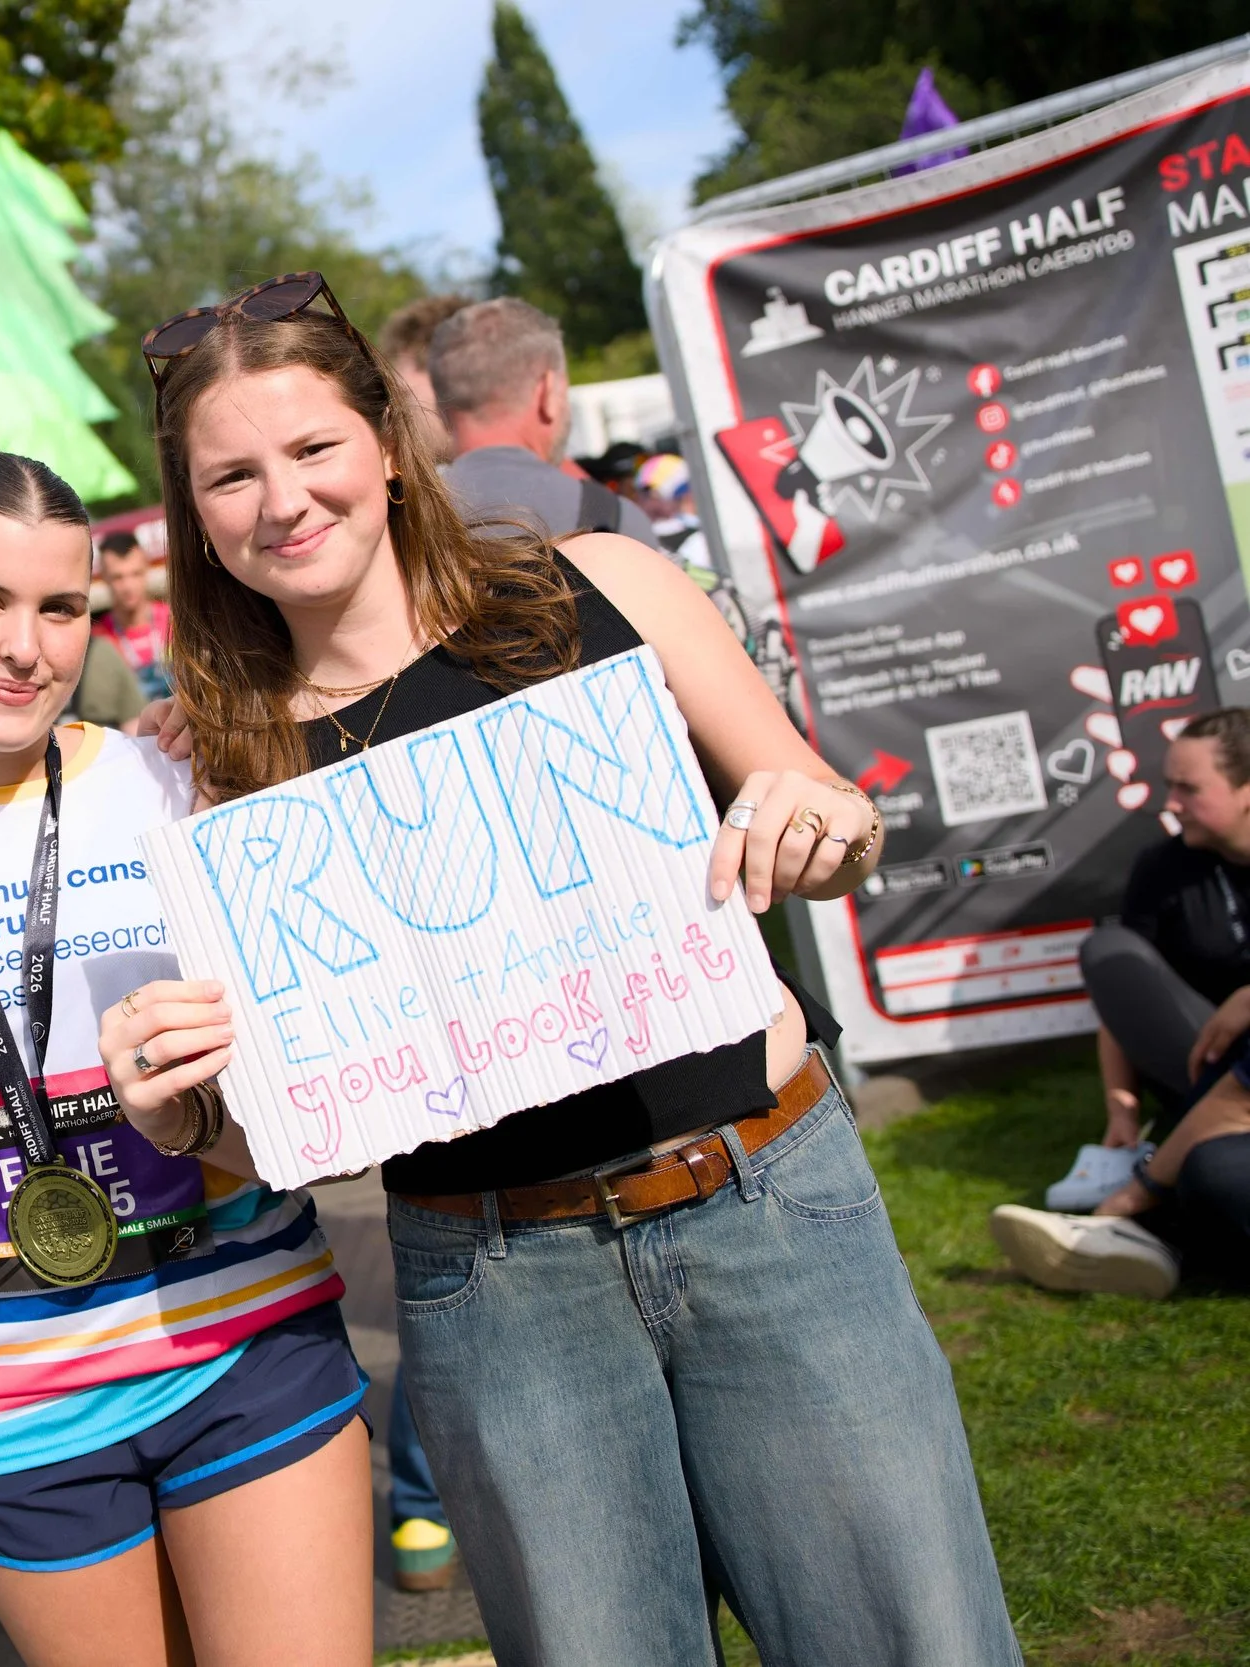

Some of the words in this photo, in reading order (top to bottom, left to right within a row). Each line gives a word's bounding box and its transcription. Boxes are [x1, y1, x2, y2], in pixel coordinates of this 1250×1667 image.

[1166, 176, 1250, 238] MA
[823, 226, 1002, 307] CARDIFF
[1009, 186, 1126, 255] HALF
[831, 294, 915, 331] HANNER
[913, 262, 1027, 311] MARATHON
[1026, 229, 1136, 279] CAERDYDD
[192, 655, 710, 1003] RUN
[44, 840, 58, 890] CARDIFF
[66, 860, 152, 888] cans
[39, 892, 53, 925] HALF
[30, 954, 45, 993] 2026
[271, 985, 428, 1066] Ellie
[287, 1043, 429, 1167] you
[622, 922, 736, 1055] fit
[5, 1085, 26, 1119] HALF
[83, 1092, 119, 1114] HAL
[18, 1121, 43, 1163] ARDIFF
[117, 1222, 146, 1236] MALE
[146, 1215, 179, 1230] SMALL
